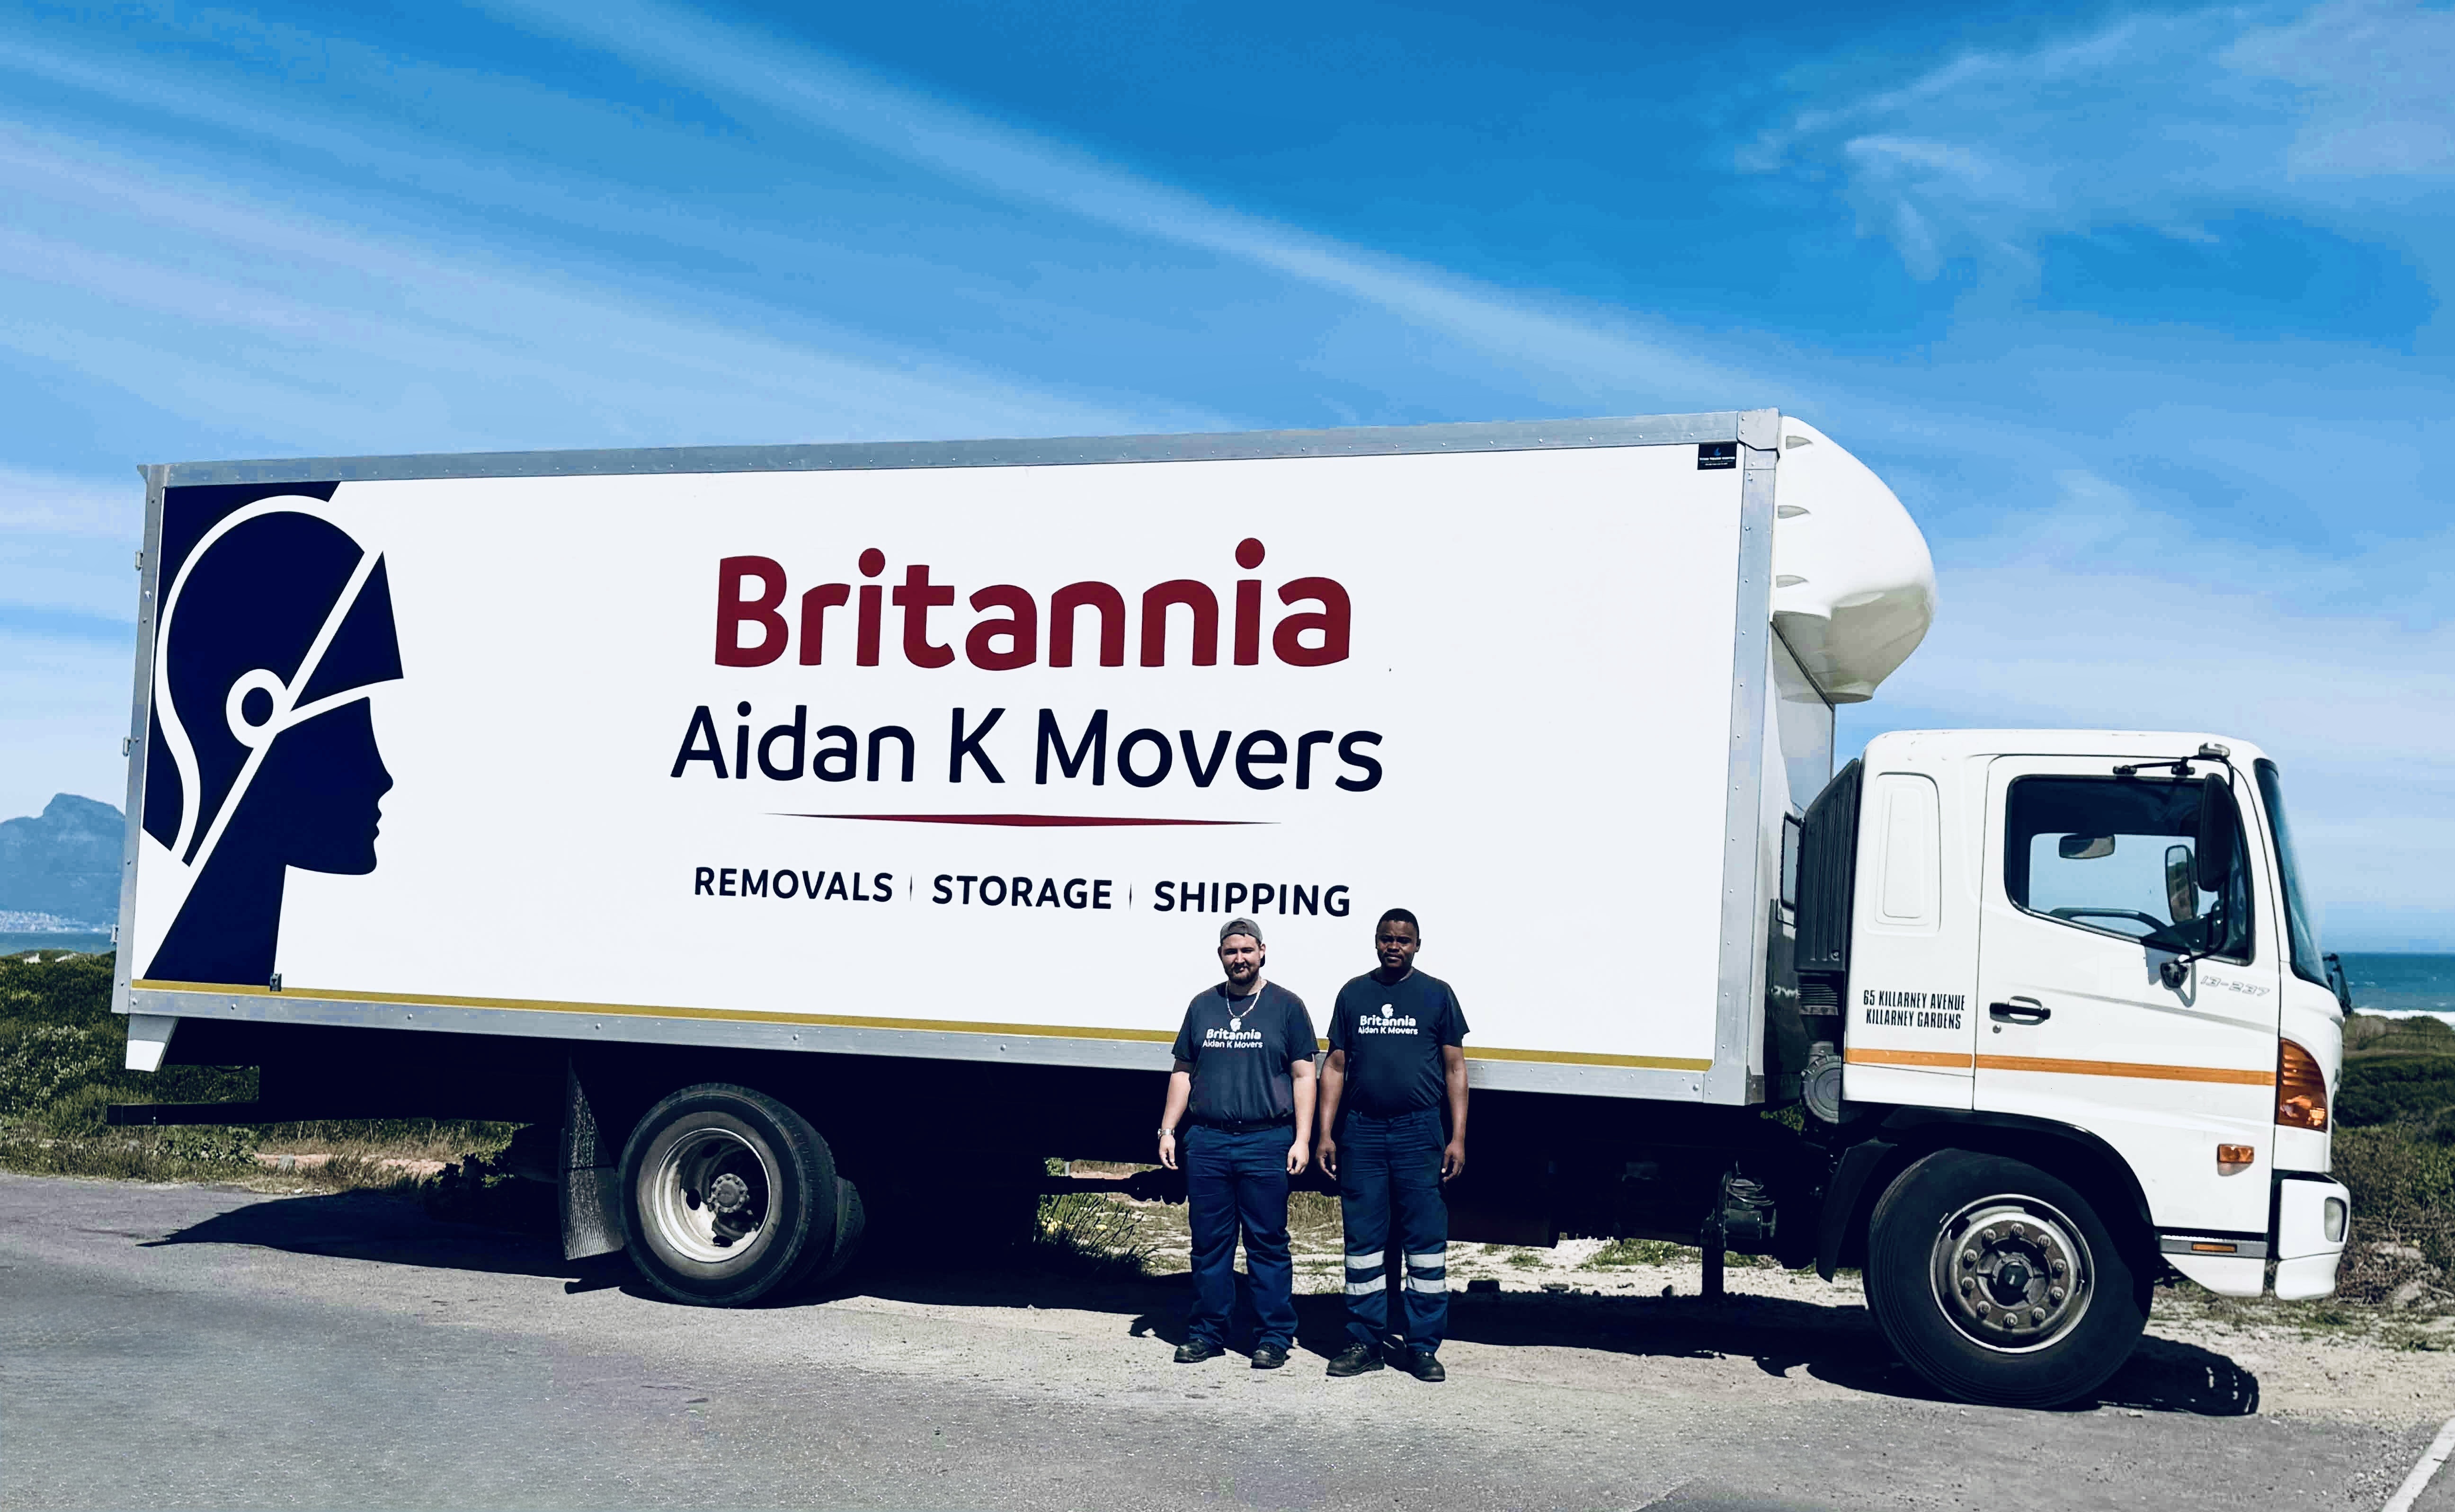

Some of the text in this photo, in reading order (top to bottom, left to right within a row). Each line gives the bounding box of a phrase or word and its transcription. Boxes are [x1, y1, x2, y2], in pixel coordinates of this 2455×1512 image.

[715, 538, 1351, 671] Britannia
[670, 701, 1383, 792] Aidan K Movers
[694, 867, 1350, 917] REMOVALS STORAGE SHIPPING
[1863, 990, 1965, 1011] 65 KILLARNEY AVENUE
[1360, 1014, 1416, 1026] Britannia
[1866, 1009, 1961, 1030] KILLARNEY GARDENS
[1206, 1028, 1262, 1040] Britannia
[1358, 1026, 1379, 1034] Aidan
[1388, 1026, 1418, 1035] Movers
[1202, 1039, 1225, 1048] Aidan
